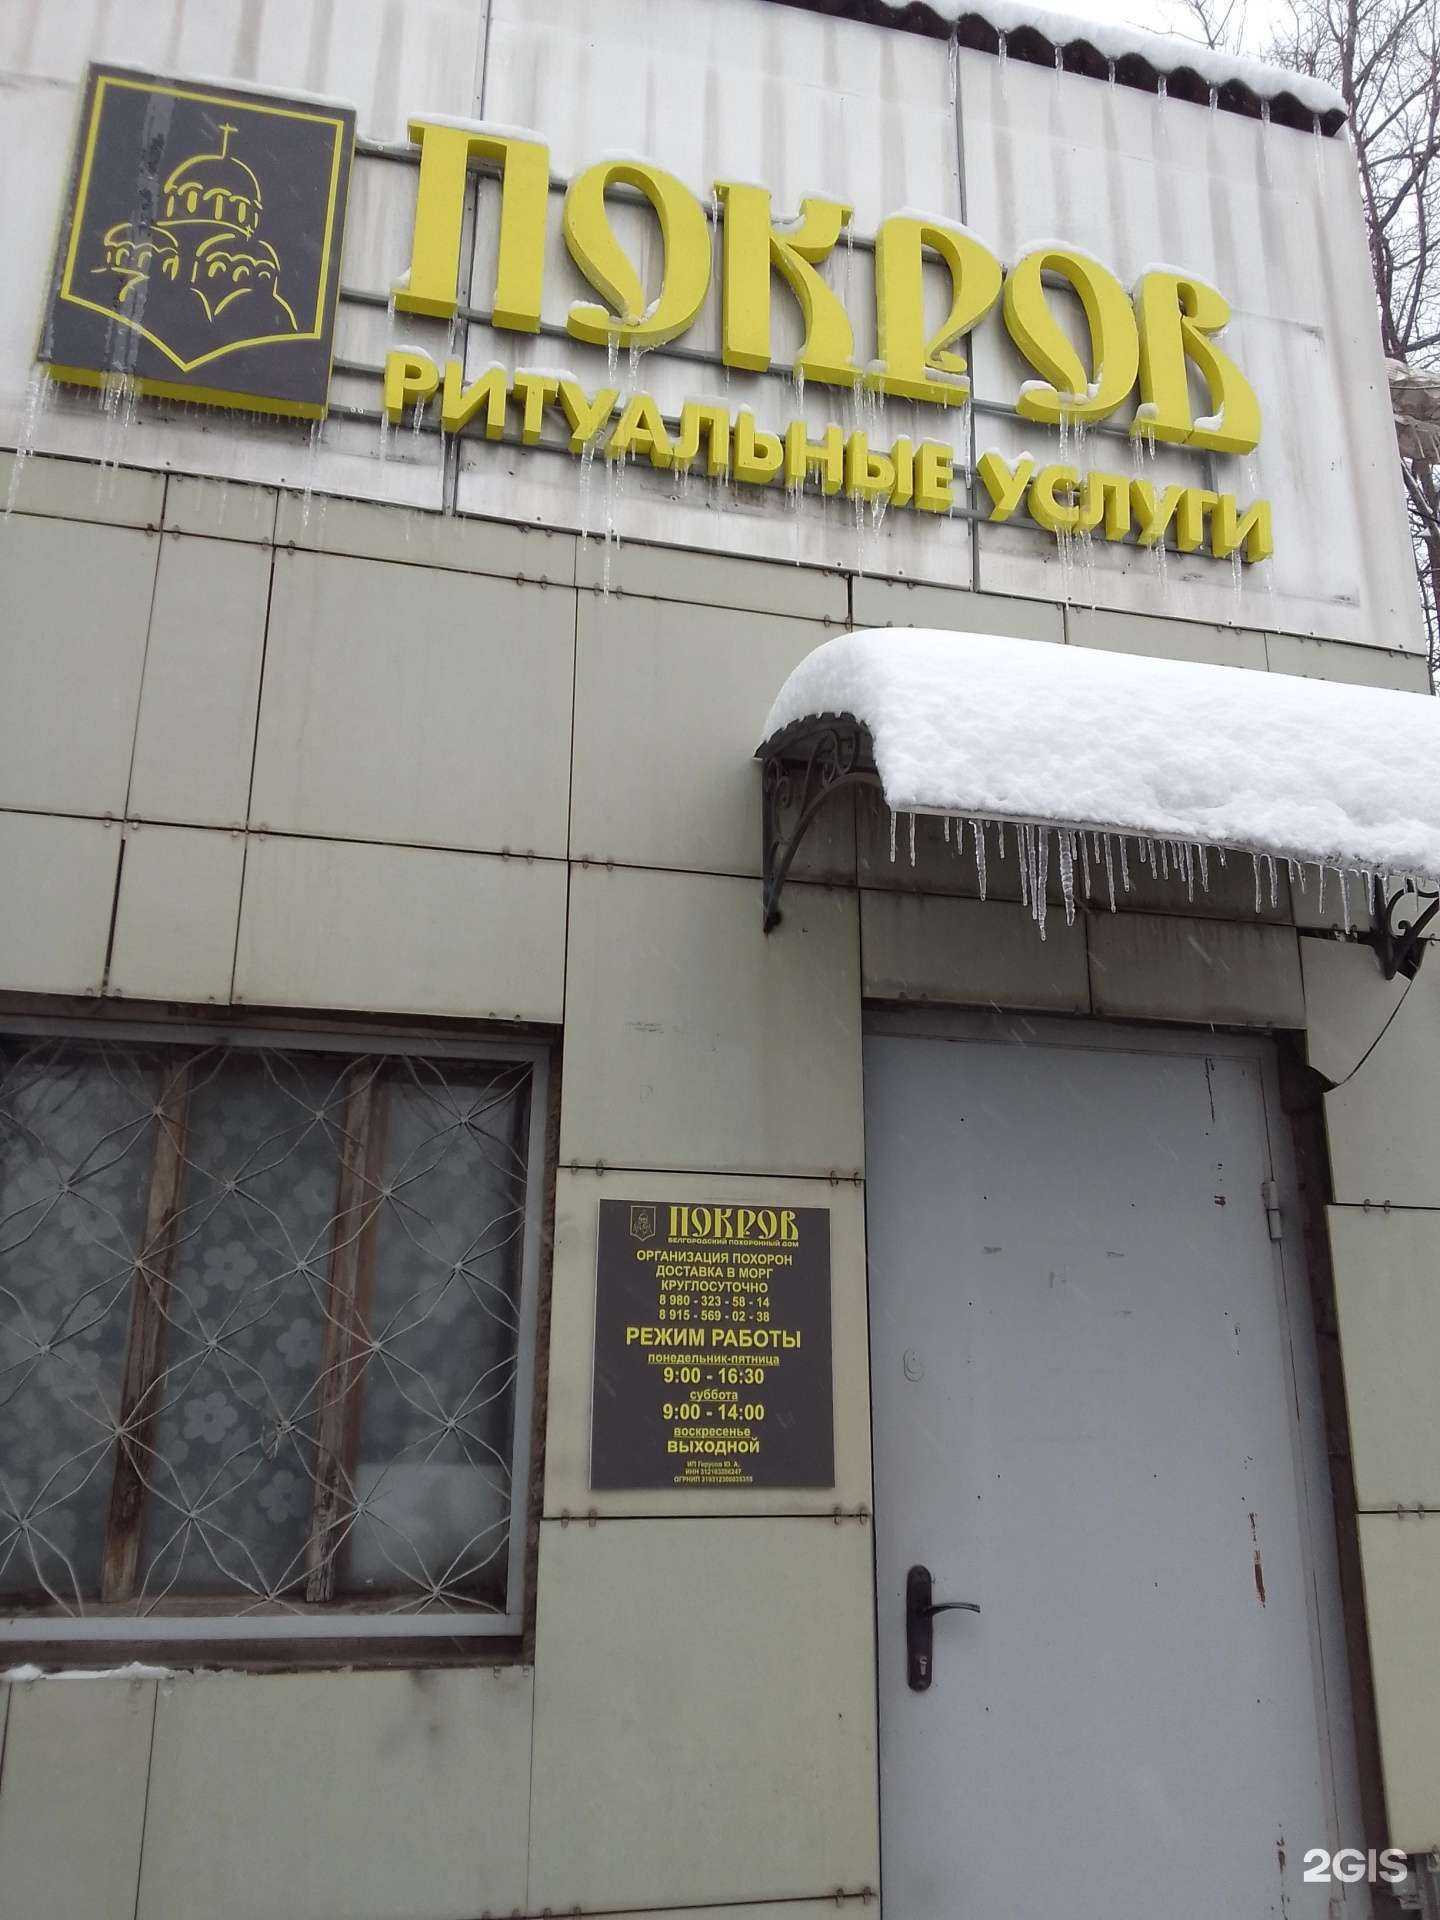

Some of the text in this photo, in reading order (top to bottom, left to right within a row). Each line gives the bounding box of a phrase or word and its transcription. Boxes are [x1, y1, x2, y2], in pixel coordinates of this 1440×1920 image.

[394, 116, 1262, 455] ПОКРОВ
[384, 349, 1275, 564] РИТУАЛЬНЫЕ УСЛУГИ
[670, 1206, 799, 1240] ПОКРОВ
[636, 1250, 792, 1265] ОРГАНИЗАЦИЯ ПОХОРОН
[656, 1265, 773, 1278] ДОСТАВКА В МОРГ
[661, 1280, 768, 1293] КРУГЛОСУТОЧНО
[660, 1294, 665, 1305] 8
[669, 1295, 690, 1305] 980
[701, 1295, 721, 1306] 323
[732, 1296, 746, 1307] 58
[756, 1297, 769, 1307] 14
[659, 1309, 665, 1320] 8
[669, 1310, 690, 1320] 915
[701, 1310, 721, 1321] 569
[732, 1311, 746, 1322] 02
[756, 1311, 769, 1322] 38
[626, 1327, 801, 1348] РЕЖИМ РАБОТЫ
[648, 1353, 779, 1366] понедельник-пятница
[663, 1367, 700, 1383] 9:00
[718, 1368, 764, 1384] 16:30
[690, 1389, 738, 1401] суббота
[663, 1404, 700, 1420] 9:00
[718, 1404, 764, 1420] 14:00
[674, 1427, 751, 1438] воскресенье
[667, 1438, 760, 1456] ВЫХОДНОЙ
